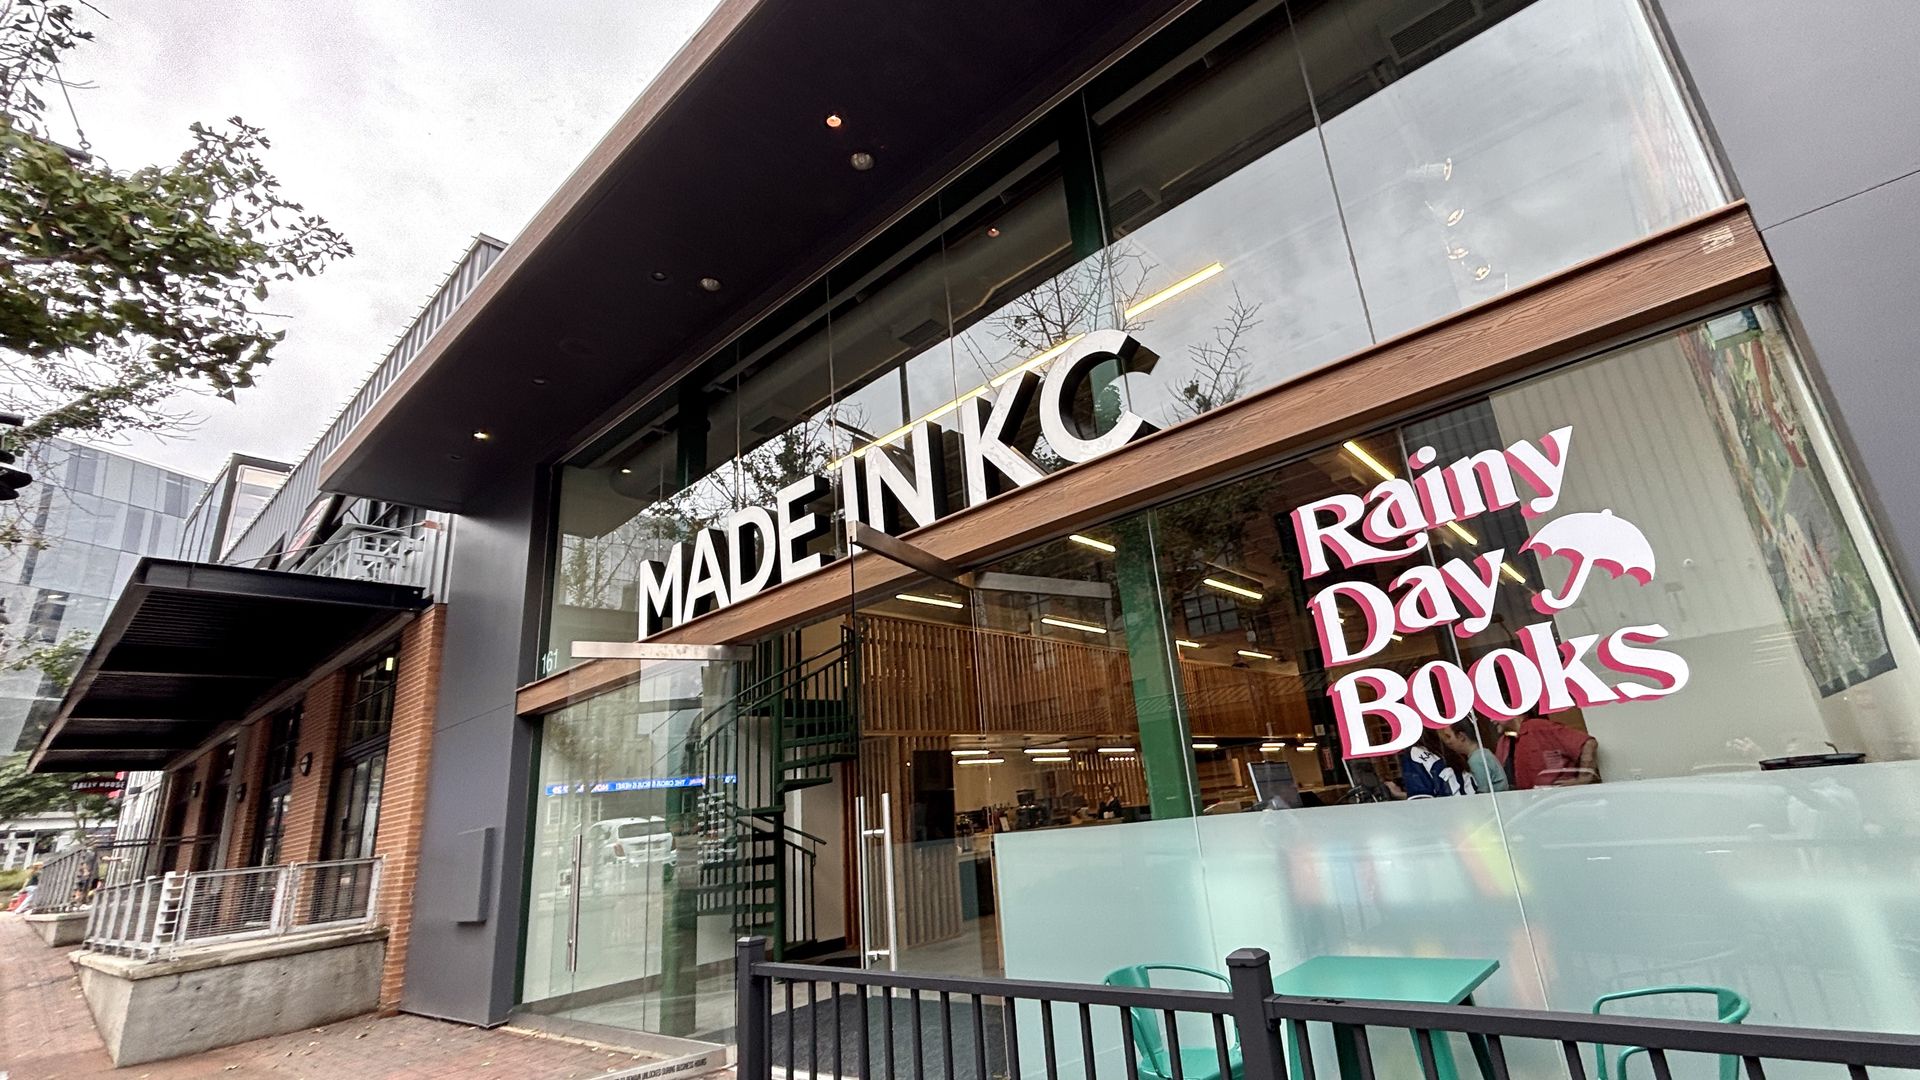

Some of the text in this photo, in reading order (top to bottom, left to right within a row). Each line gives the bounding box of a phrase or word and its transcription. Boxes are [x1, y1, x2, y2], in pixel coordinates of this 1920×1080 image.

[638, 329, 1160, 642] MADE IN KC
[1290, 425, 1573, 580] Rainy
[542, 648, 559, 675] 161
[1307, 548, 1506, 668] Day
[1326, 620, 1690, 760] Books
